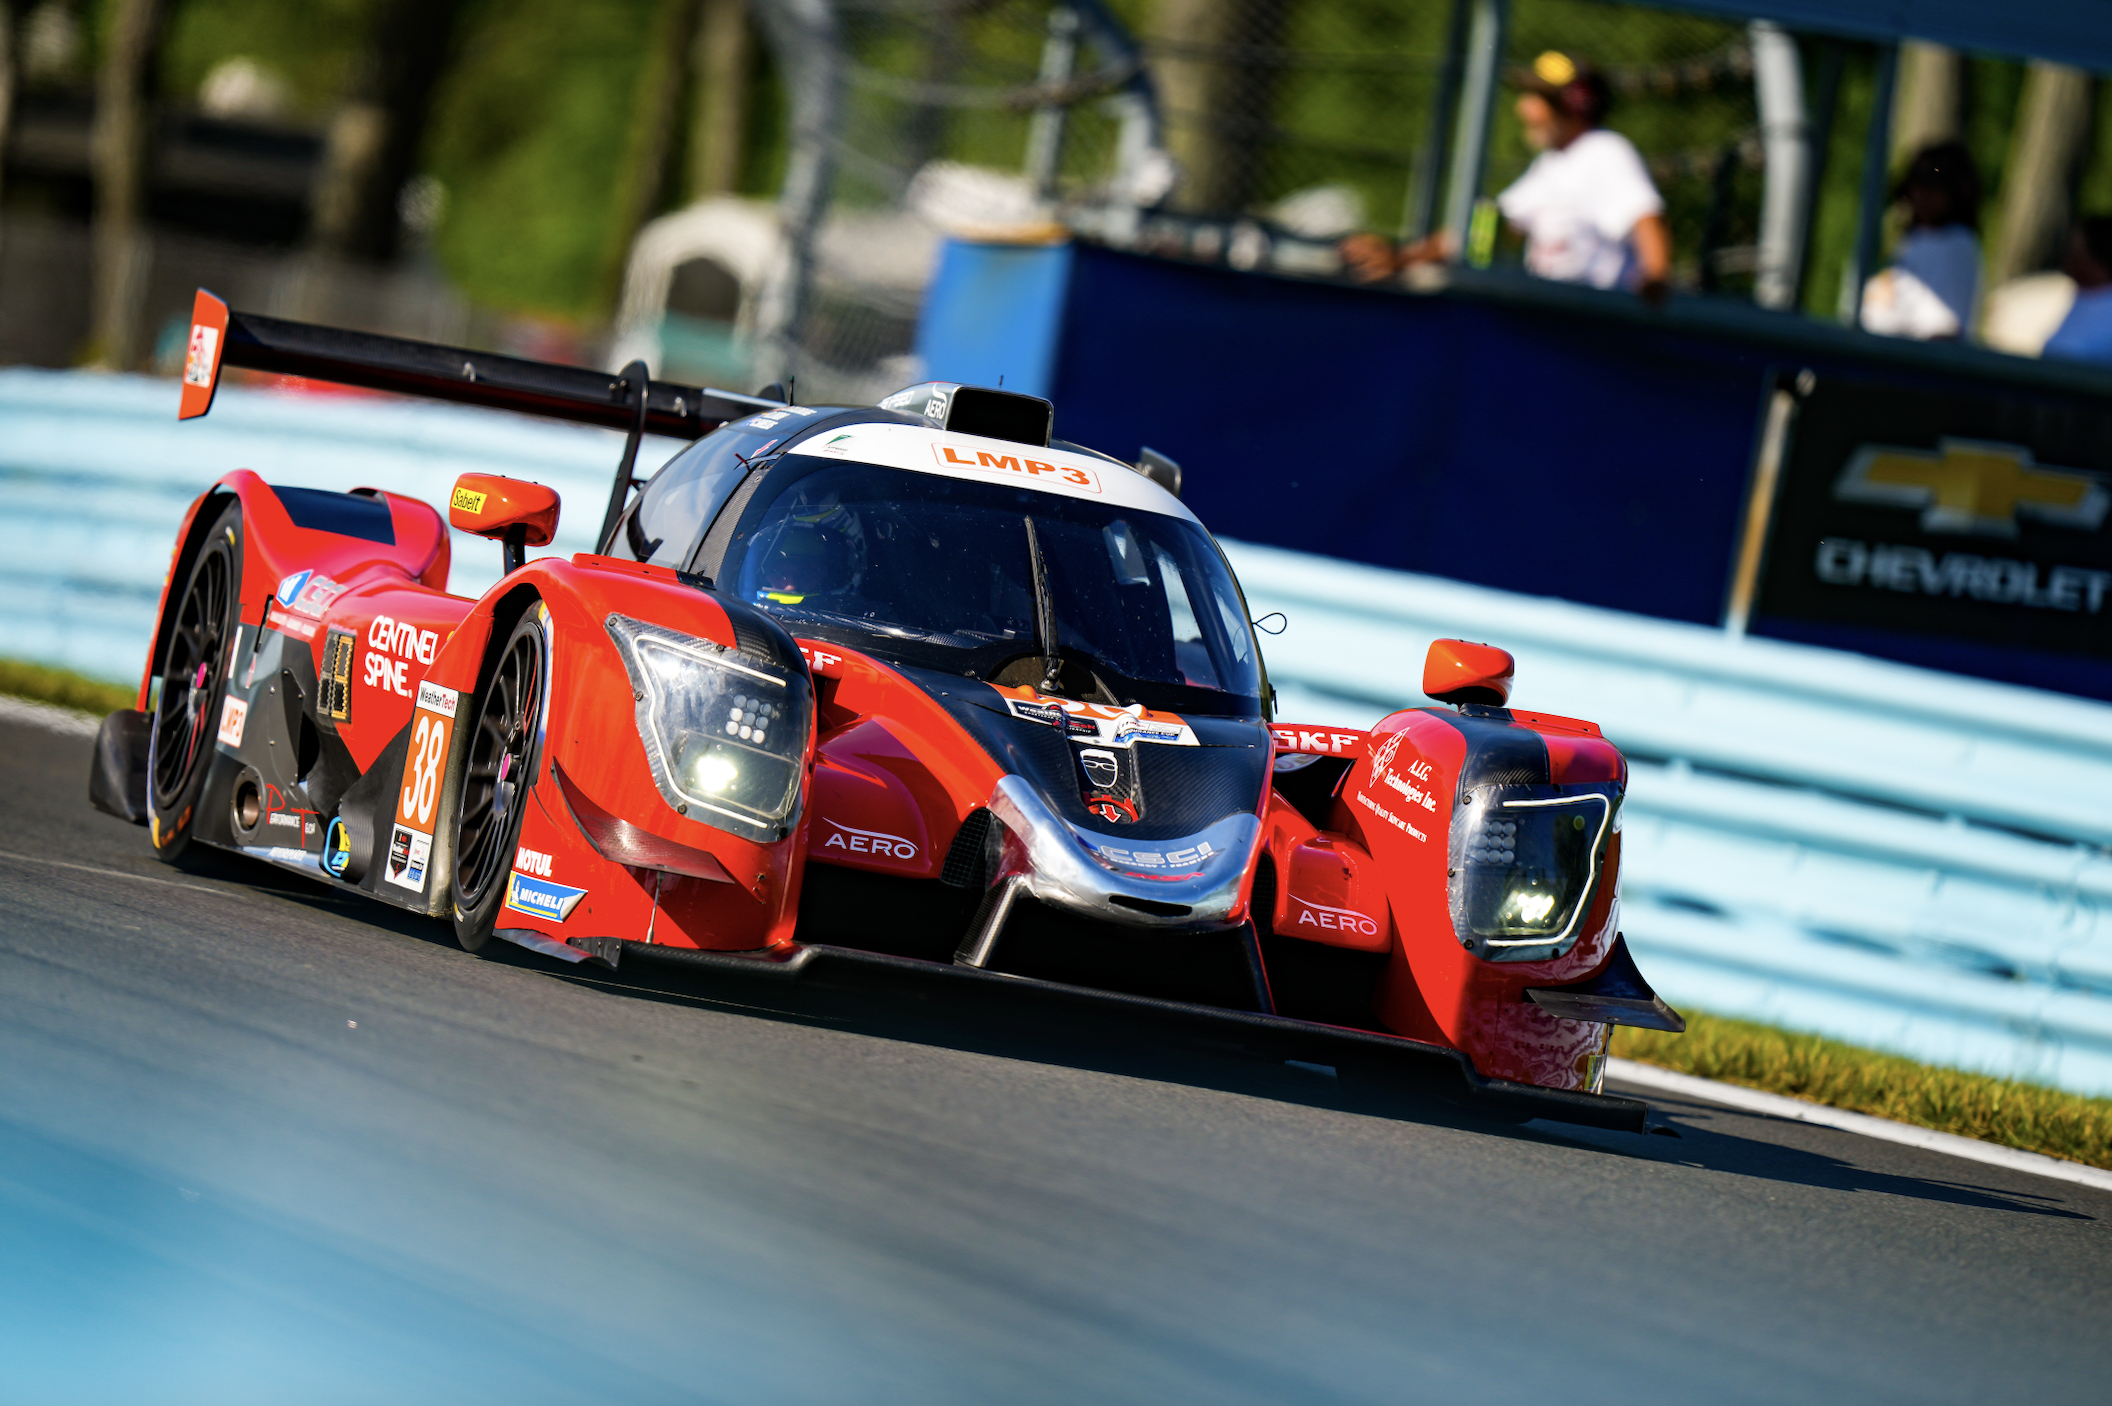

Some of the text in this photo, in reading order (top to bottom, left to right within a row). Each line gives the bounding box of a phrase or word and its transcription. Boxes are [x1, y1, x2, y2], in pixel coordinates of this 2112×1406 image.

[923, 398, 946, 420] AERO
[942, 447, 1090, 486] LMP3
[453, 489, 481, 512] Sabelt
[1816, 538, 2112, 612] CHEVROLET
[420, 686, 455, 712] WeatherTech
[220, 704, 245, 738] LMP3
[1272, 729, 1359, 753] SKF
[403, 715, 444, 825] 38
[1384, 767, 1424, 803] Technologies
[1421, 791, 1437, 813] Inc.
[825, 832, 915, 860] AERO
[1100, 841, 1212, 865] CSCI
[515, 846, 553, 877] MOTUL
[519, 887, 565, 911] MICHELI
[1298, 909, 1378, 936] AERO
